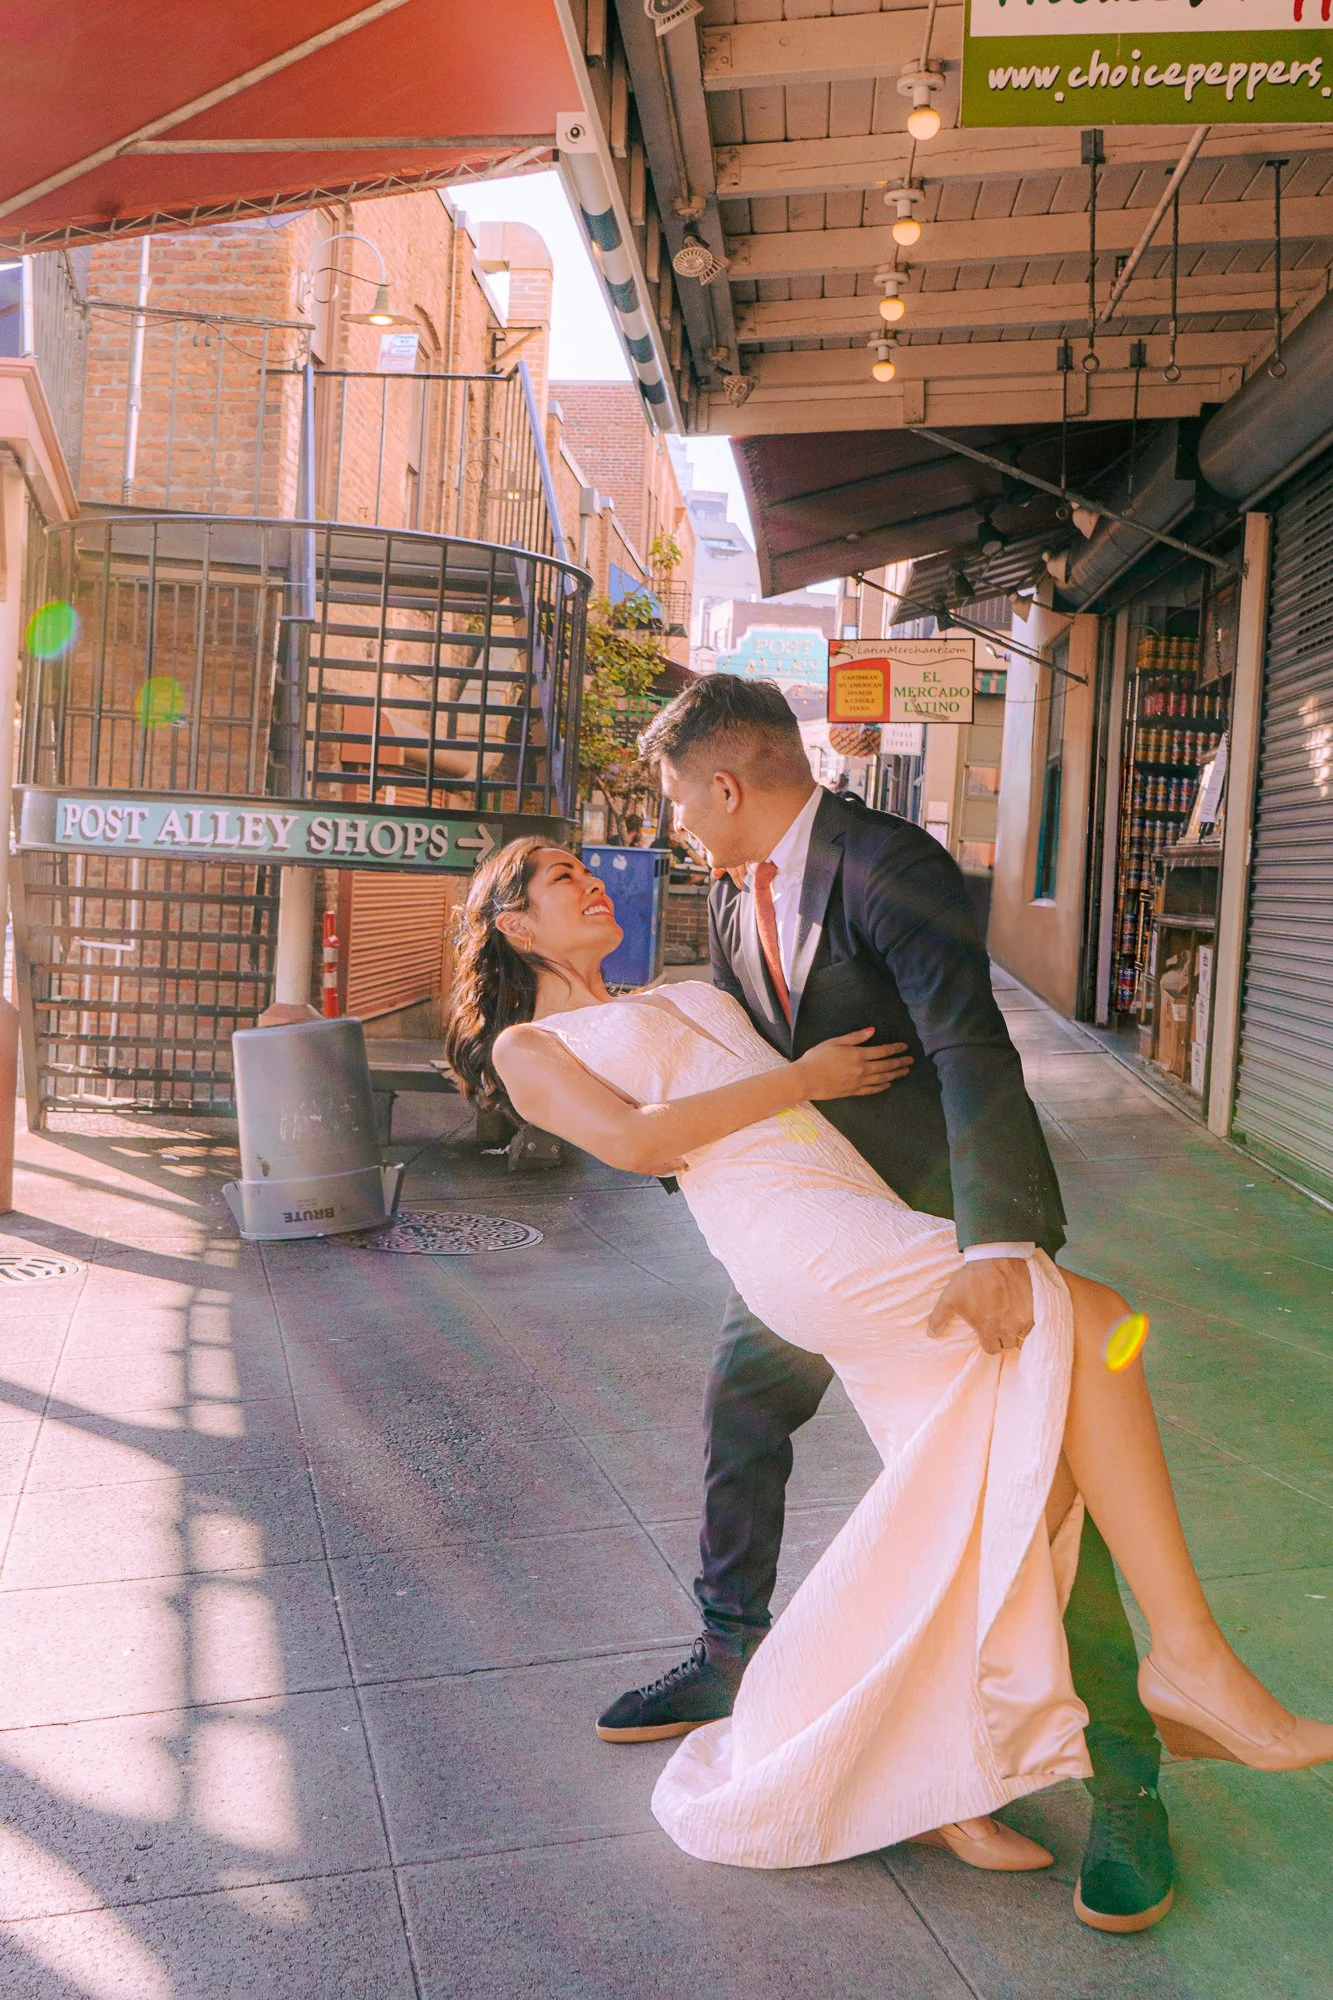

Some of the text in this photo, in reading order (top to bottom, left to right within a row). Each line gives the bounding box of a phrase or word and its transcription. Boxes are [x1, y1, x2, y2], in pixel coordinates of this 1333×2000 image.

[754, 636, 815, 656] POST
[857, 645, 968, 655] LatinMerchant.com
[744, 658, 822, 677] ALLEY
[922, 671, 941, 683] EL
[894, 686, 970, 698] MERCADO
[904, 701, 960, 713] LATINO
[63, 803, 449, 859] POST ALLEY SHOPS
[282, 1207, 335, 1223] BRUTE
